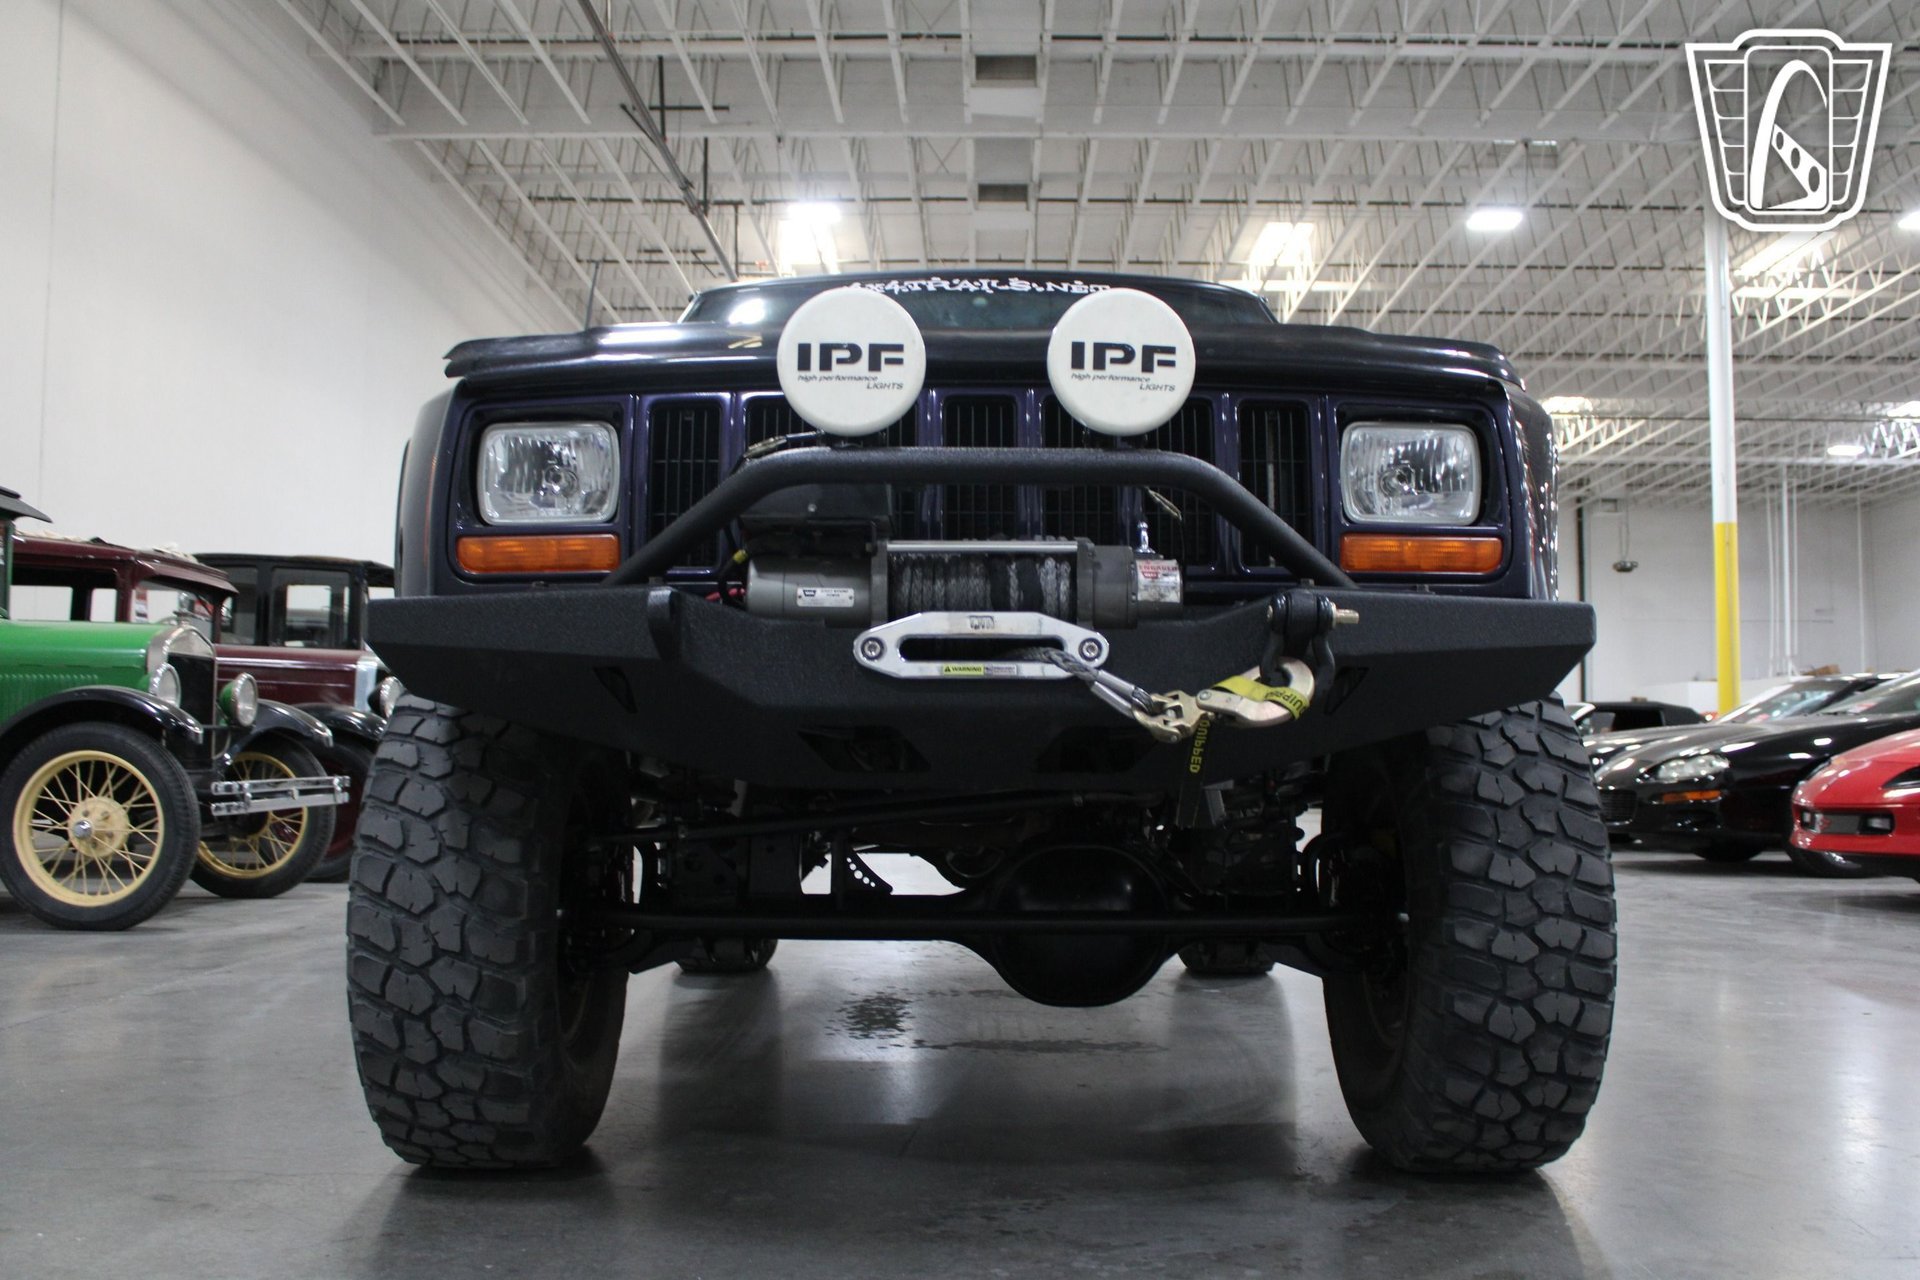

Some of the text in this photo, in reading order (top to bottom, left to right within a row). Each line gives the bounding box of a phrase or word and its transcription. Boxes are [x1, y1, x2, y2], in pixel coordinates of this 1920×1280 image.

[797, 343, 904, 372] IPF
[1071, 341, 1176, 373] IPF
[797, 374, 878, 382] high performance
[1071, 373, 1151, 383] high performance
[866, 382, 904, 390] LIGHTS
[1139, 383, 1176, 392] LIGHTS
